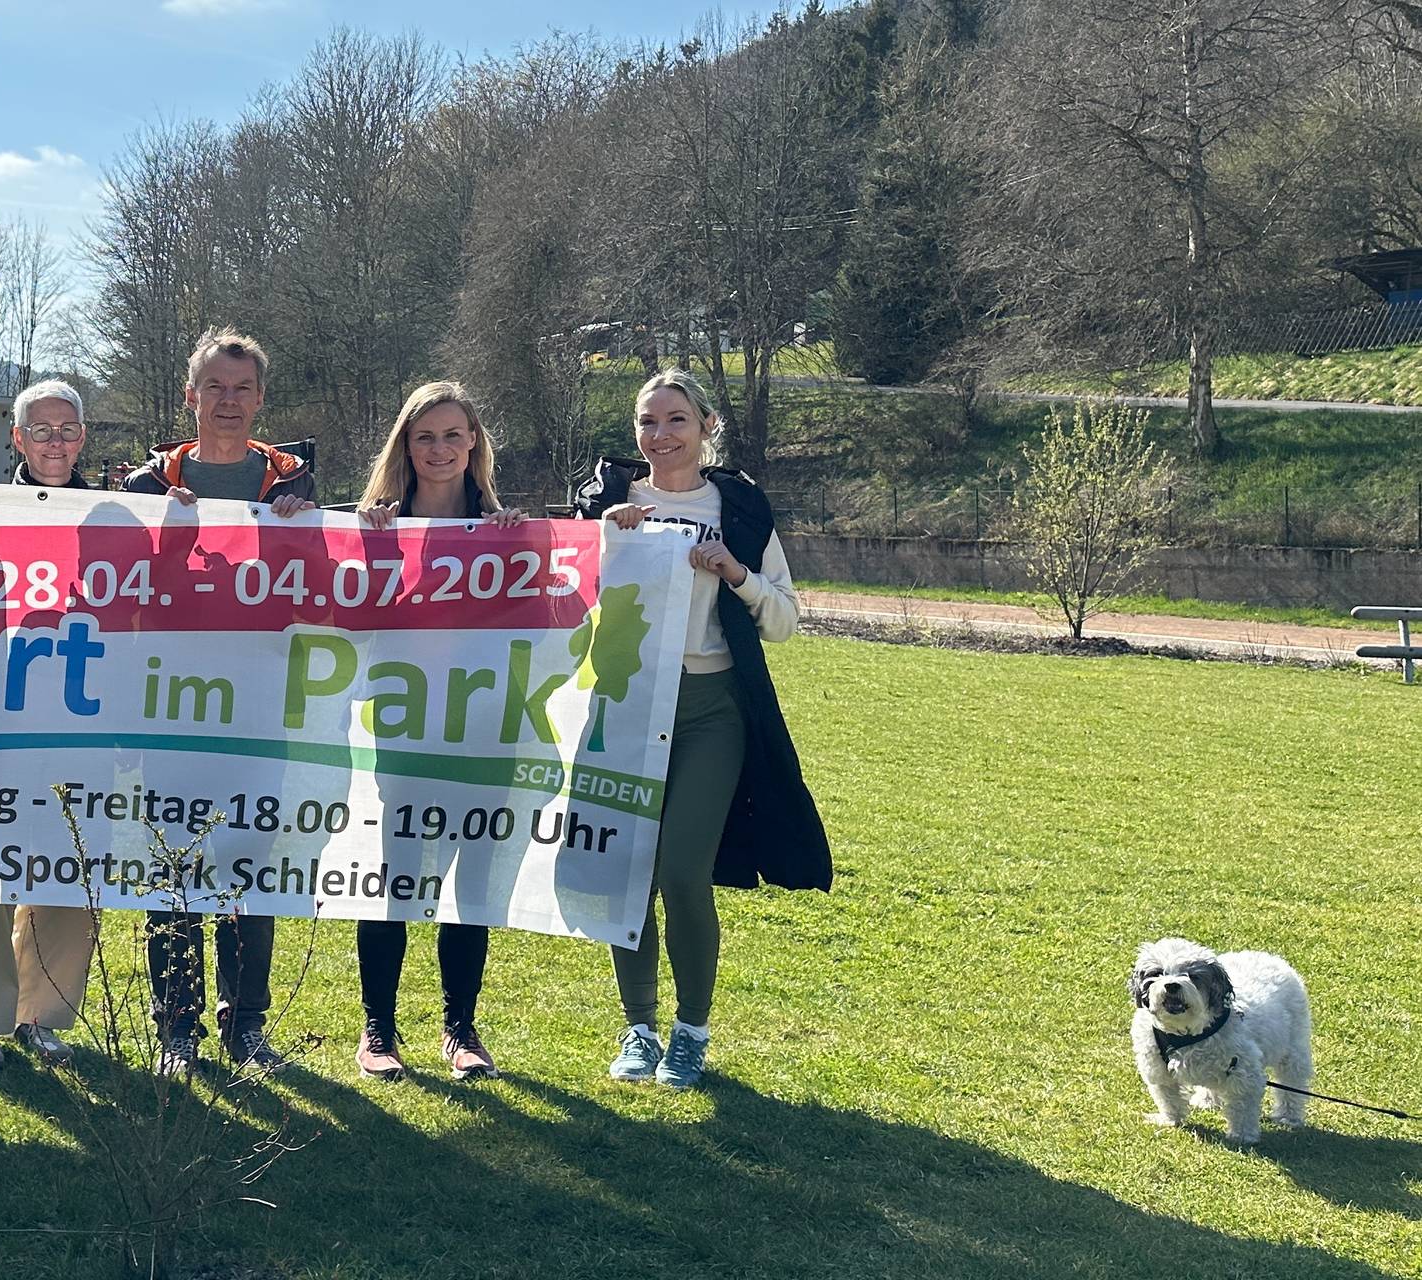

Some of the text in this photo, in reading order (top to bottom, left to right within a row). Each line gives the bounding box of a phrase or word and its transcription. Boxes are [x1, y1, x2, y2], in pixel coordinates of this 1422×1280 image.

[194, 581, 215, 592] -
[234, 547, 581, 608] 04.07.2025
[143, 656, 234, 723] im
[283, 633, 569, 744] Park
[514, 763, 653, 807] SCHLEIDEN
[62, 783, 213, 834] Freitag
[228, 793, 349, 834] 18.00
[394, 804, 515, 841] 19.00
[530, 809, 618, 854] Uhr
[0, 845, 442, 901] Sportpark Schleiden
